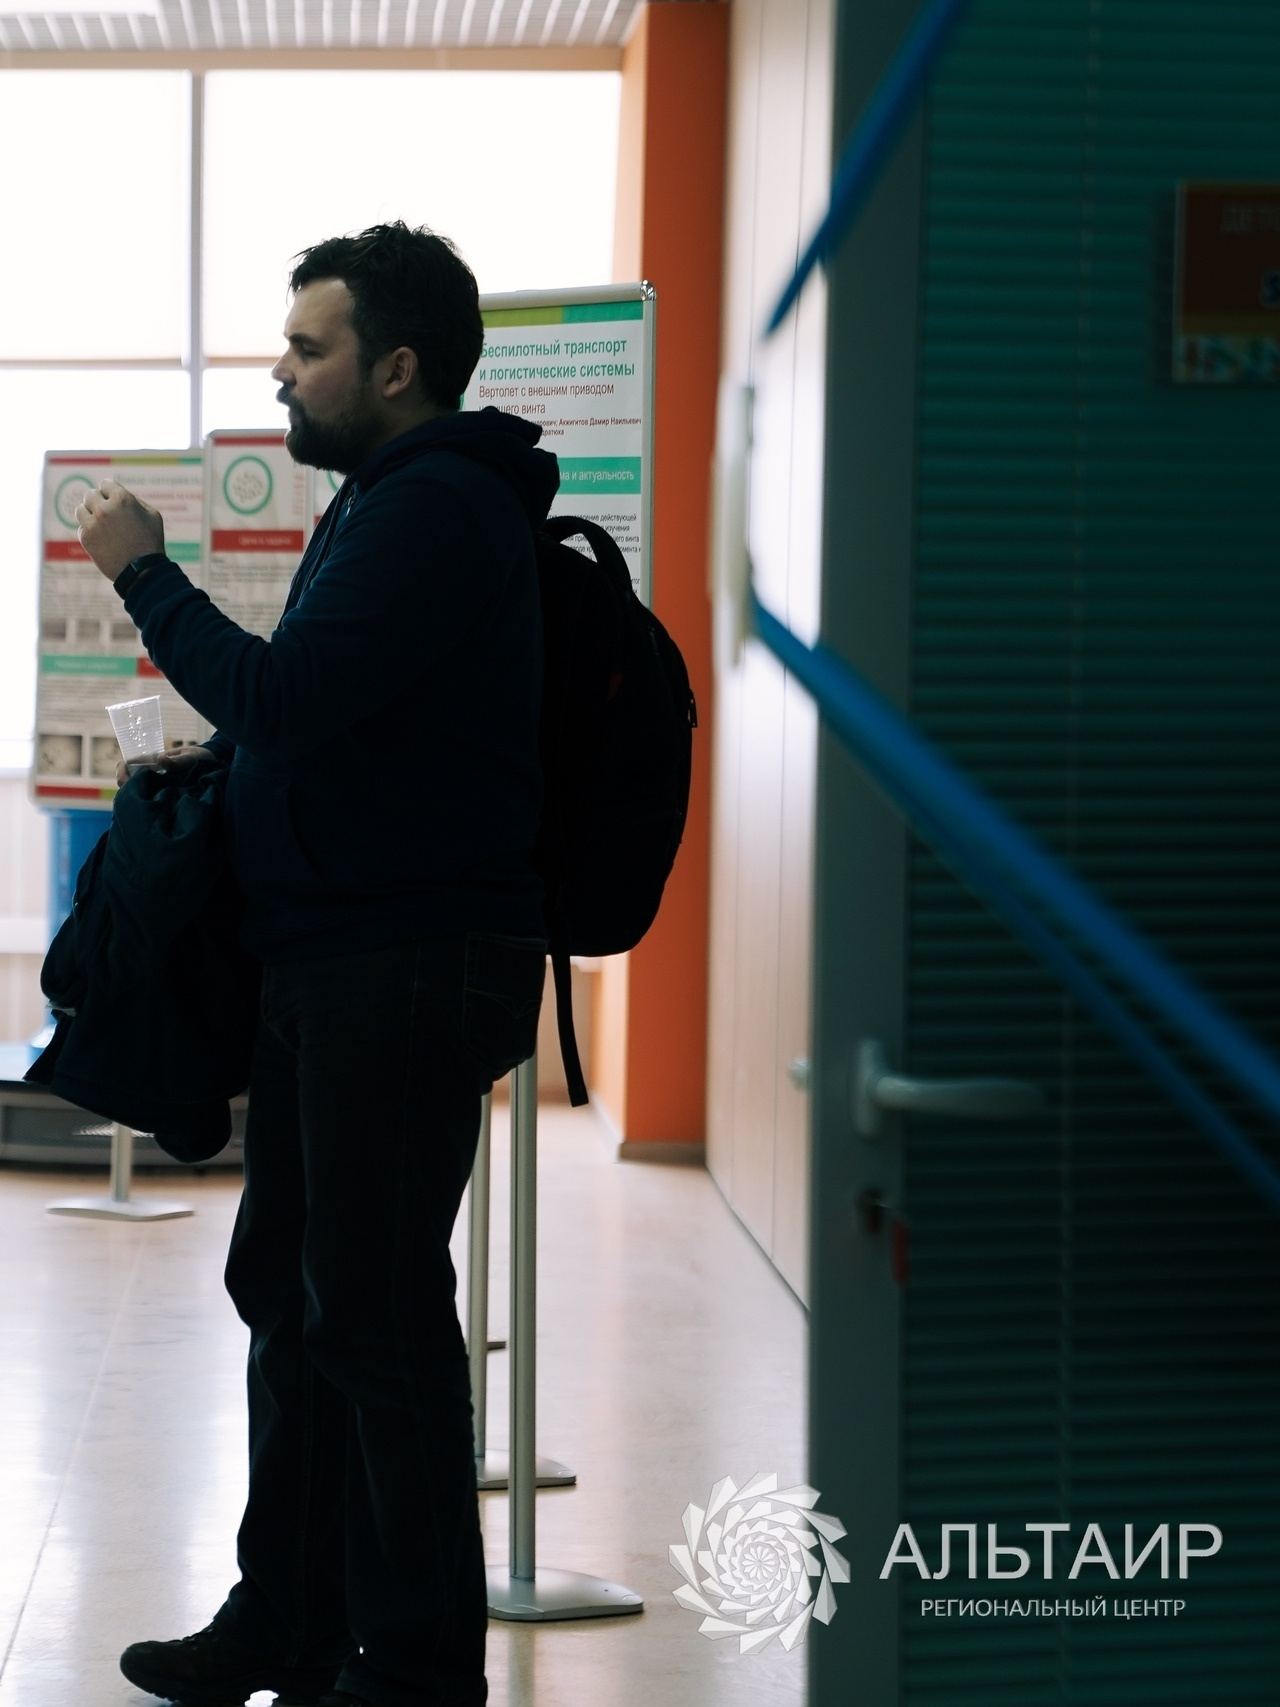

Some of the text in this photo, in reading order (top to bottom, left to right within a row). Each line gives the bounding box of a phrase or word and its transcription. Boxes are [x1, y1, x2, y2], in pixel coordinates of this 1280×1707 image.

[481, 339, 627, 360] Беспилотный транспорт
[479, 362, 635, 381] и логистические системы
[479, 383, 614, 400] Вертолет с внешним приводом
[521, 404, 546, 415] винта
[589, 417, 609, 427] Дамир
[578, 470, 635, 484] актуальность
[599, 513, 637, 523] действующей
